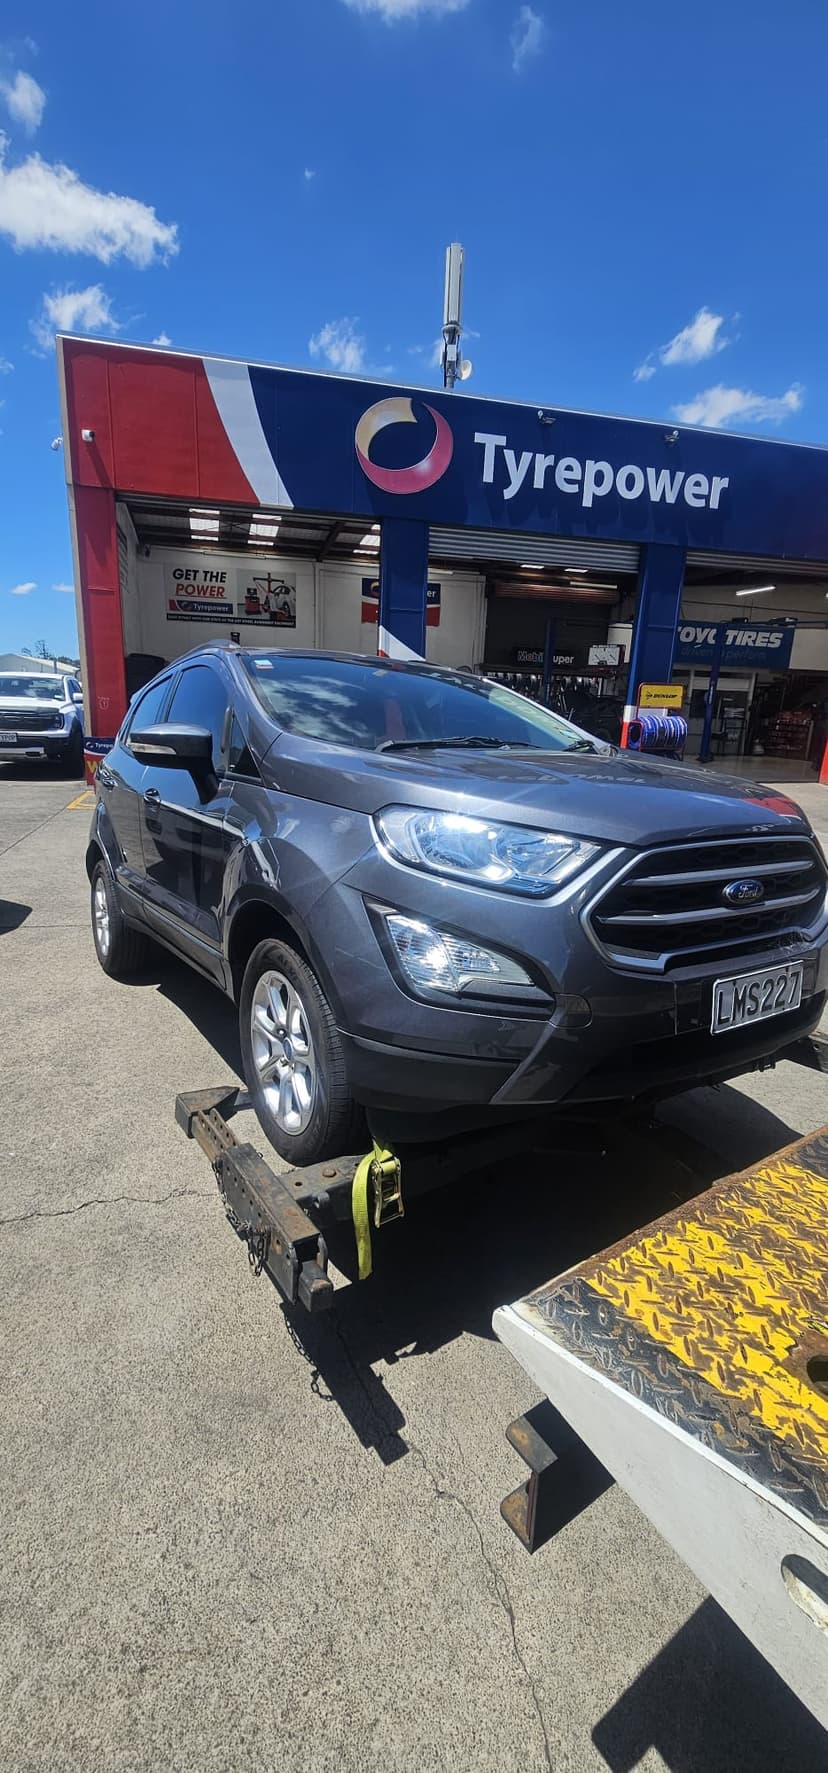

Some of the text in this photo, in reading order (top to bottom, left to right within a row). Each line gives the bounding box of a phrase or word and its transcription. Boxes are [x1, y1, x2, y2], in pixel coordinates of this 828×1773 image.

[474, 432, 729, 509] Tyrepower
[173, 568, 227, 583] GET THE
[176, 583, 225, 597] POWER
[194, 603, 229, 613] Tyrepower
[725, 629, 784, 648] TIRES
[738, 884, 758, 898] Ford
[717, 973, 801, 1026] LMS227
